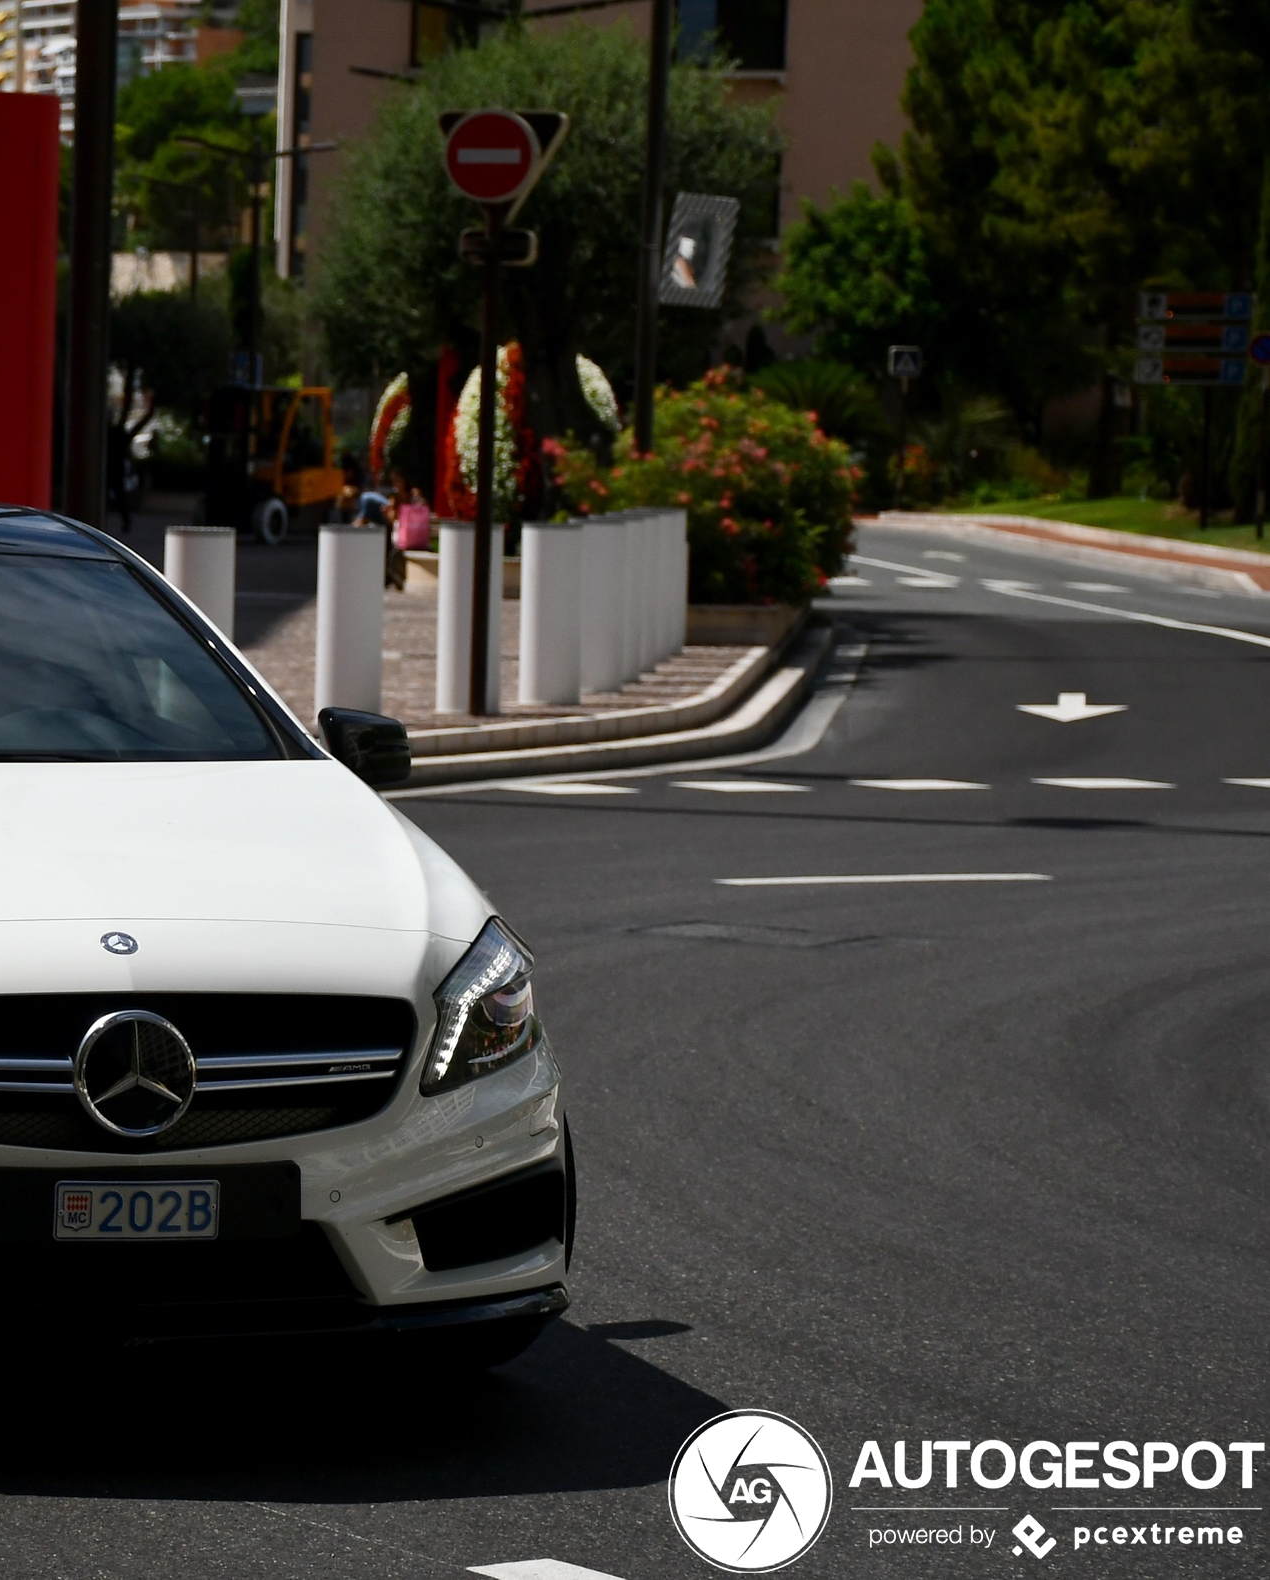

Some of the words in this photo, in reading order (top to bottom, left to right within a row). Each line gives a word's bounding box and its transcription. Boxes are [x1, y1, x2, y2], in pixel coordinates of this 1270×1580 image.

[341, 1063, 371, 1072] AMG
[67, 1211, 87, 1224] MC
[98, 1190, 212, 1232] 202B
